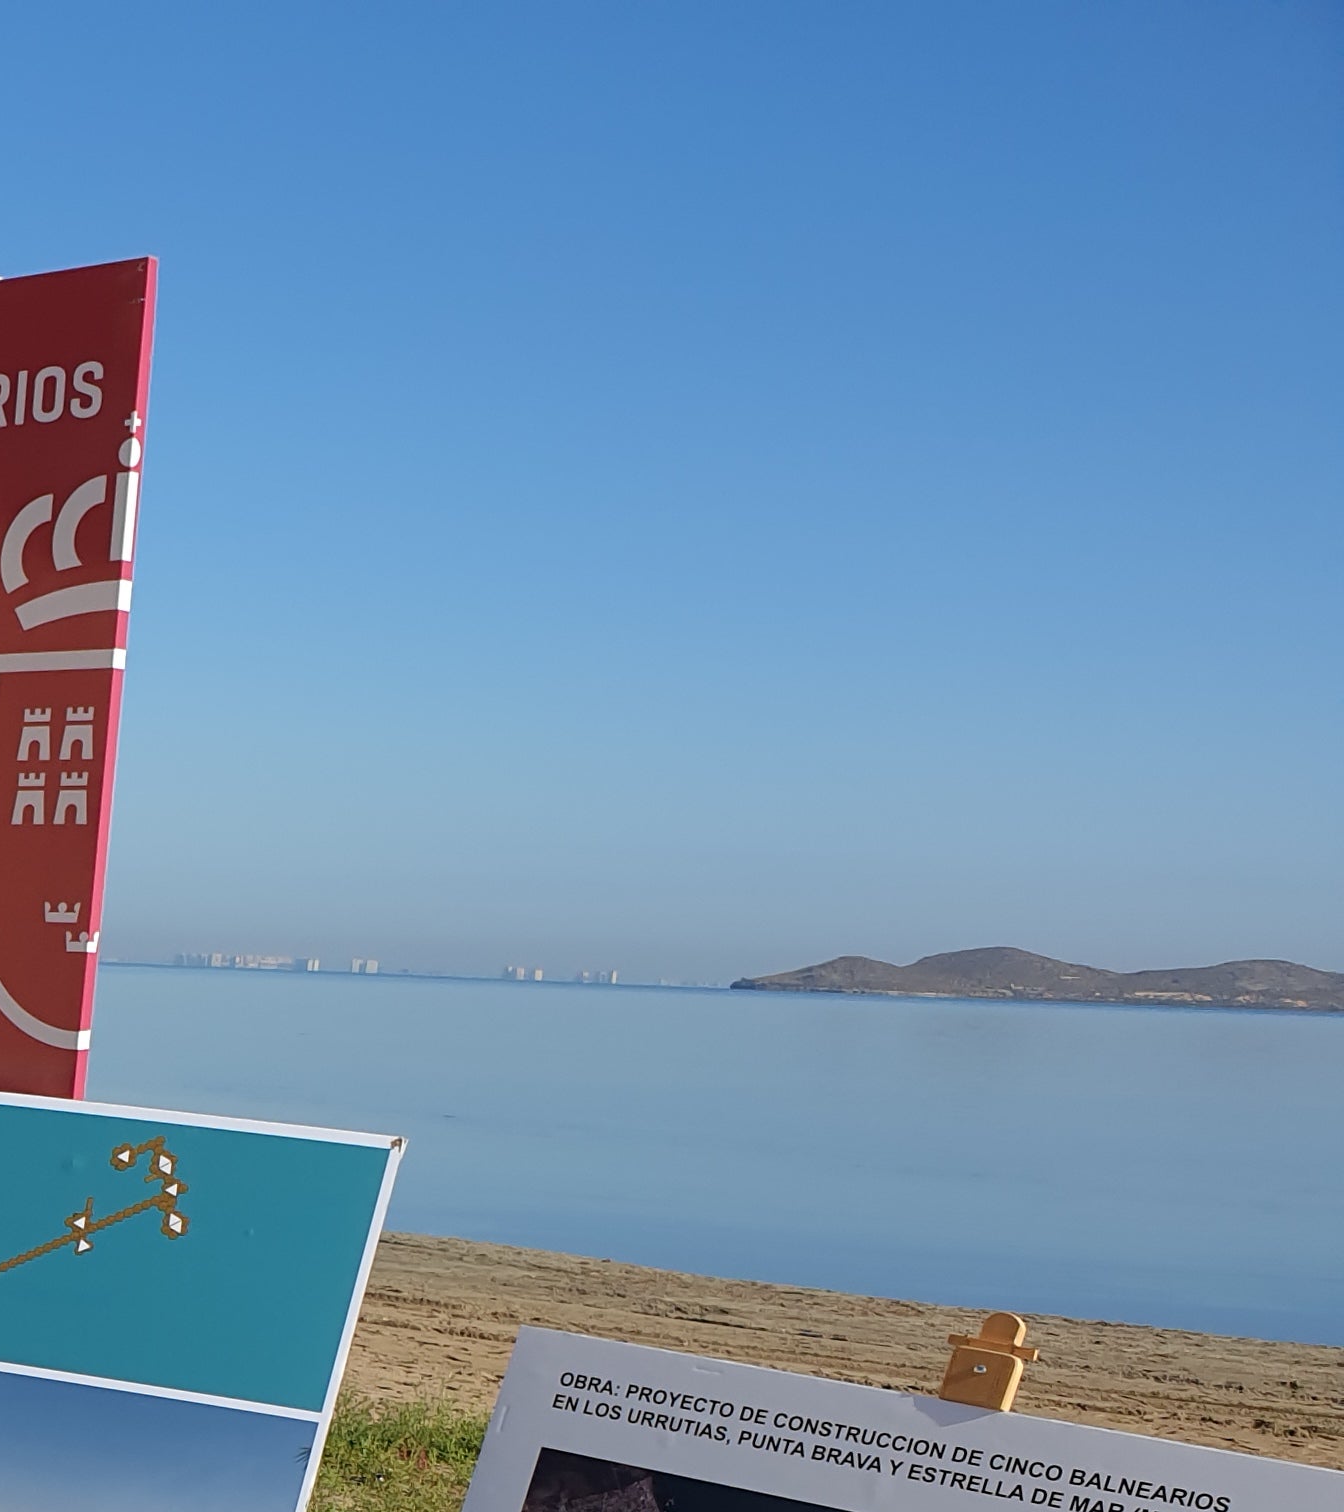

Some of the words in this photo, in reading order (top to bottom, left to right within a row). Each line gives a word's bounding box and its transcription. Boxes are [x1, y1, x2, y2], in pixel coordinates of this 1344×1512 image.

[552, 1394, 578, 1412] EN
[583, 1401, 621, 1420] LOS
[627, 1410, 732, 1445] URRUTIAS,
[738, 1431, 805, 1458] PUNTA
[811, 1445, 881, 1472] BRAVA
[890, 1459, 903, 1477] Y
[907, 1464, 1024, 1501] ESTRELLA
[1030, 1488, 1063, 1508] DE
[560, 1372, 621, 1397] OBRA:
[626, 1384, 733, 1418] PROYECTO
[739, 1406, 768, 1425] DE
[774, 1413, 946, 1460] CONSTRUCCION
[951, 1446, 984, 1467] DE
[990, 1454, 1062, 1481] CINCO
